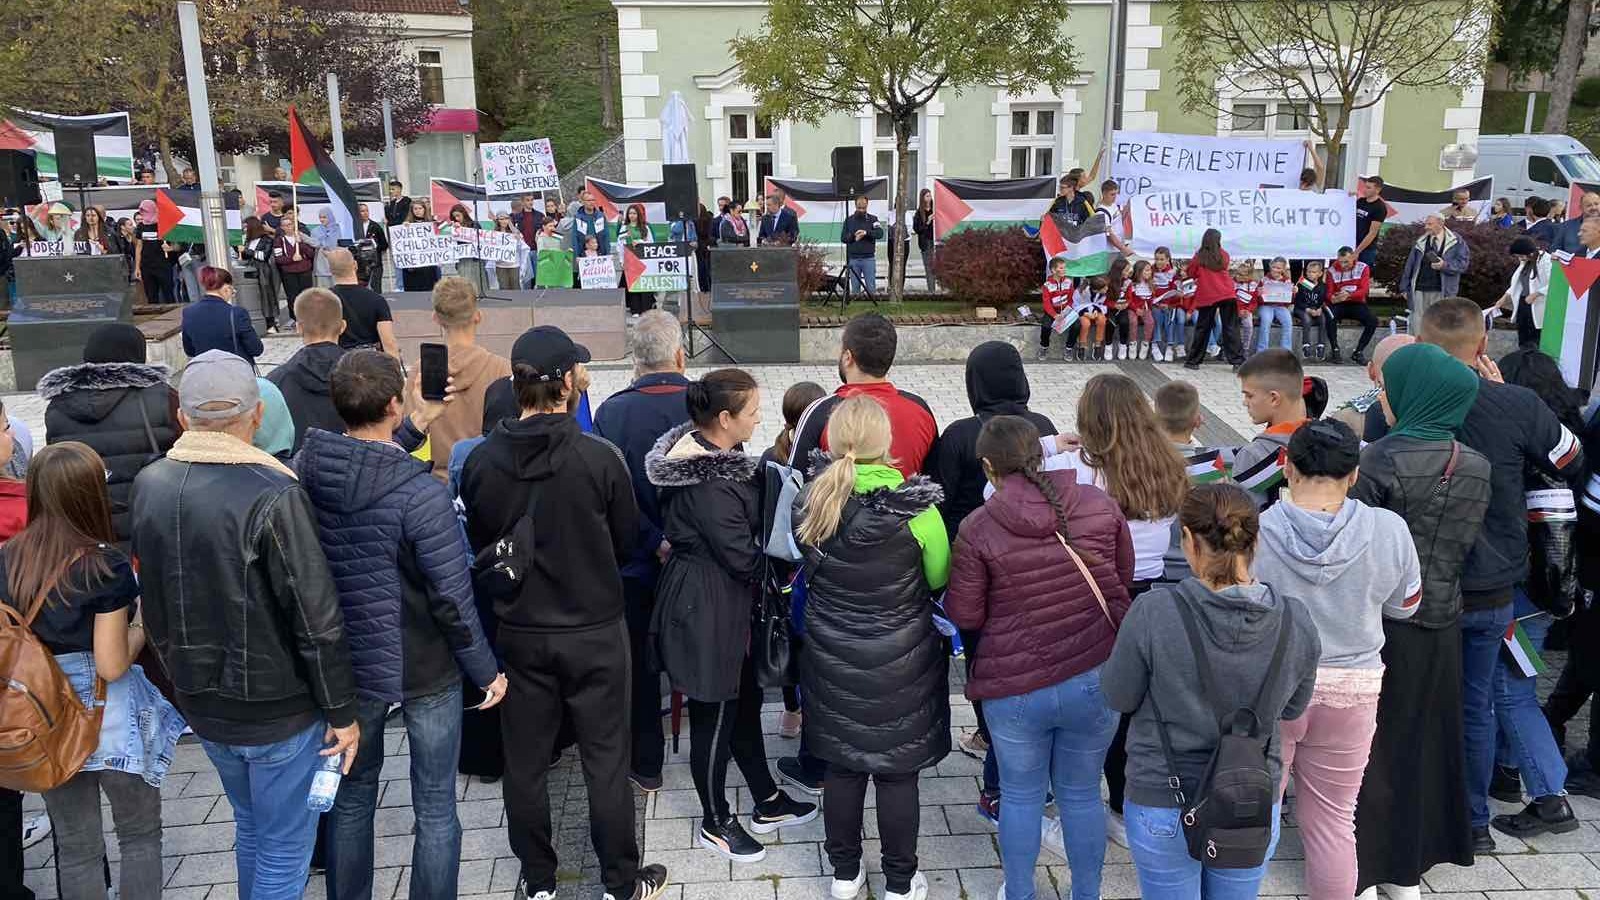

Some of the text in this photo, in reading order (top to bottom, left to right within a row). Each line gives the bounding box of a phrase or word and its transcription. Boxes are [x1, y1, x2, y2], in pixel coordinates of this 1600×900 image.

[498, 142, 541, 156] BOMBING
[508, 154, 535, 165] KIDS
[1116, 143, 1289, 174] FREE PALESTINE
[505, 163, 539, 176] IS NOT
[495, 175, 558, 191] SELF-DEFENSE
[1110, 176, 1152, 195] TOP
[1145, 189, 1267, 211] CHILDREN
[1150, 211, 1193, 227] HAVE
[1201, 209, 1242, 226] THE
[1252, 206, 1311, 226] RIGHT
[1314, 208, 1342, 226] TO
[394, 225, 432, 240] WHEN
[501, 233, 511, 246] IS
[395, 236, 452, 252] CHILDREN
[643, 245, 678, 258] PEACE
[395, 250, 450, 267] ARE DYING
[453, 244, 469, 256] NOT
[483, 245, 516, 262] OPTION
[583, 256, 608, 267] STOP
[658, 260, 680, 274] FOR
